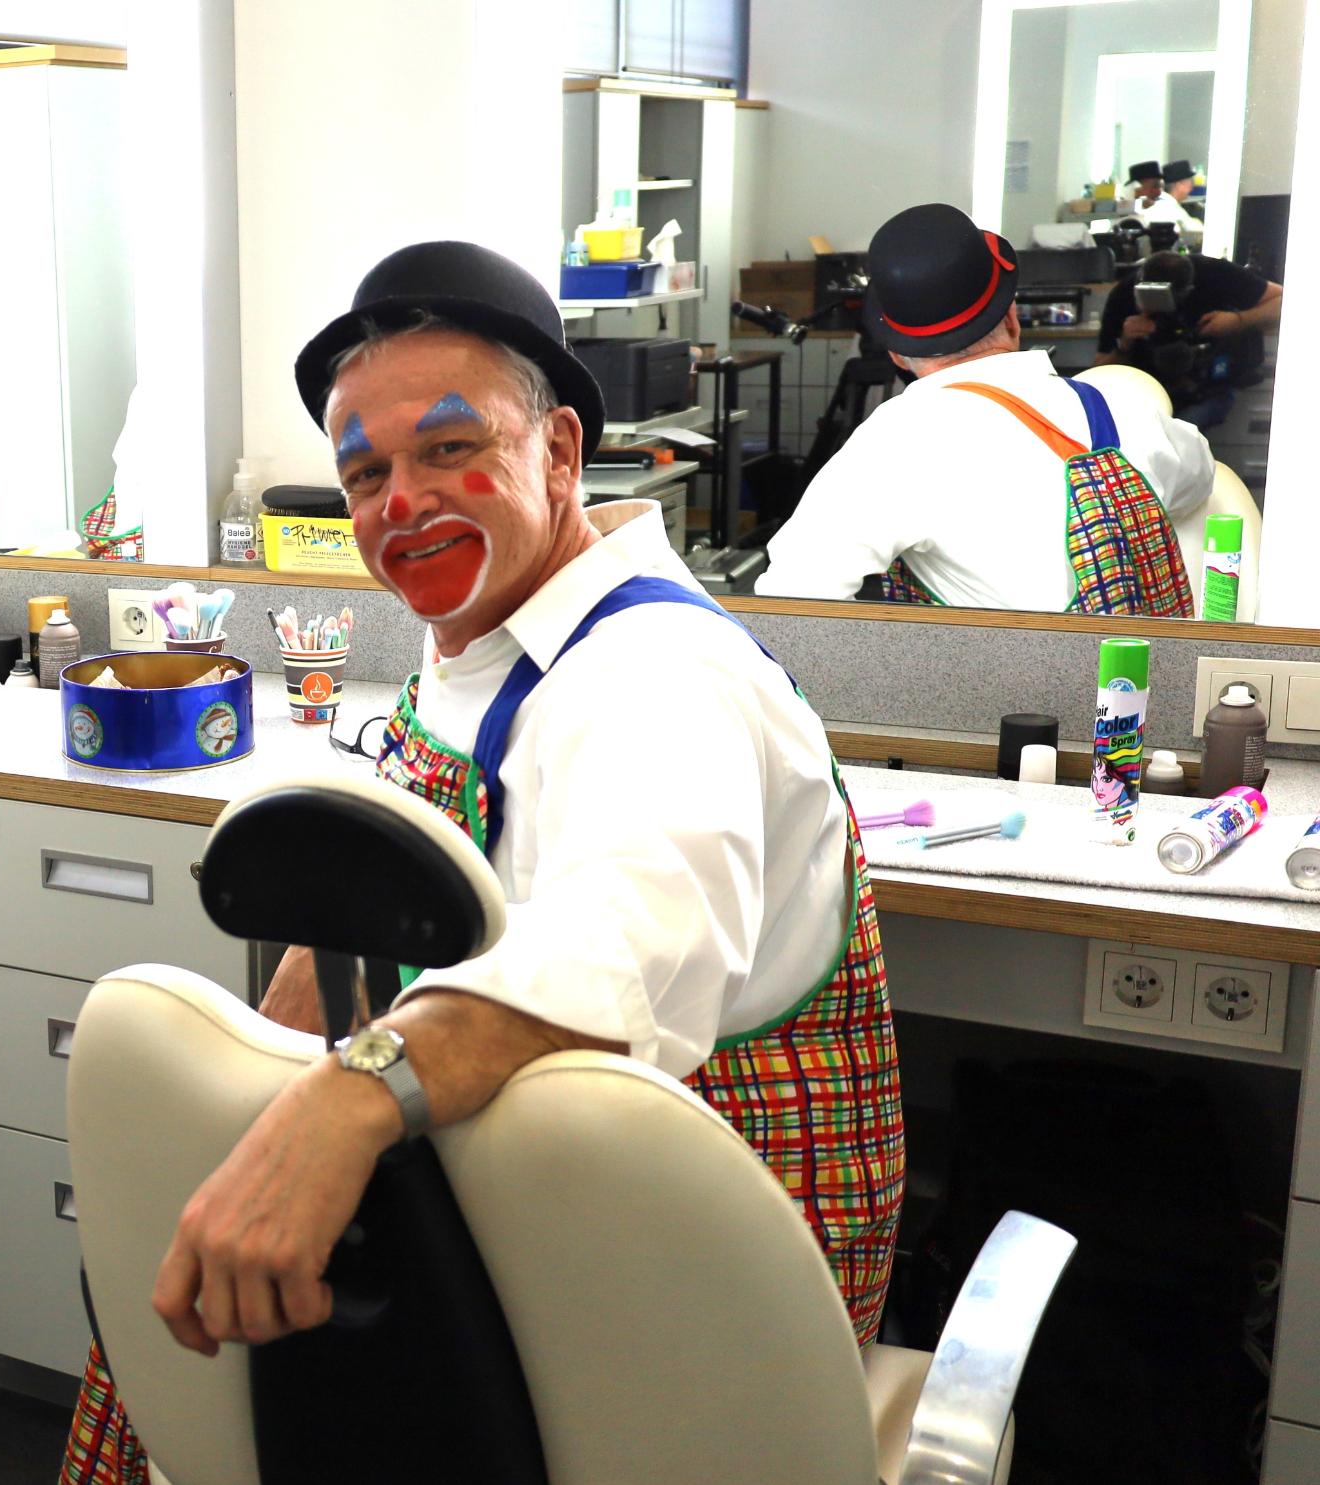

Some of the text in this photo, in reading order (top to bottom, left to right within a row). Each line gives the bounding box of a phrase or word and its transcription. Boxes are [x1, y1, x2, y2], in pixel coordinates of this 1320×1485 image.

[227, 528, 251, 537] Balea
[1096, 704, 1108, 717] air
[1096, 714, 1137, 735] Color
[1110, 735, 1137, 748] Spray
